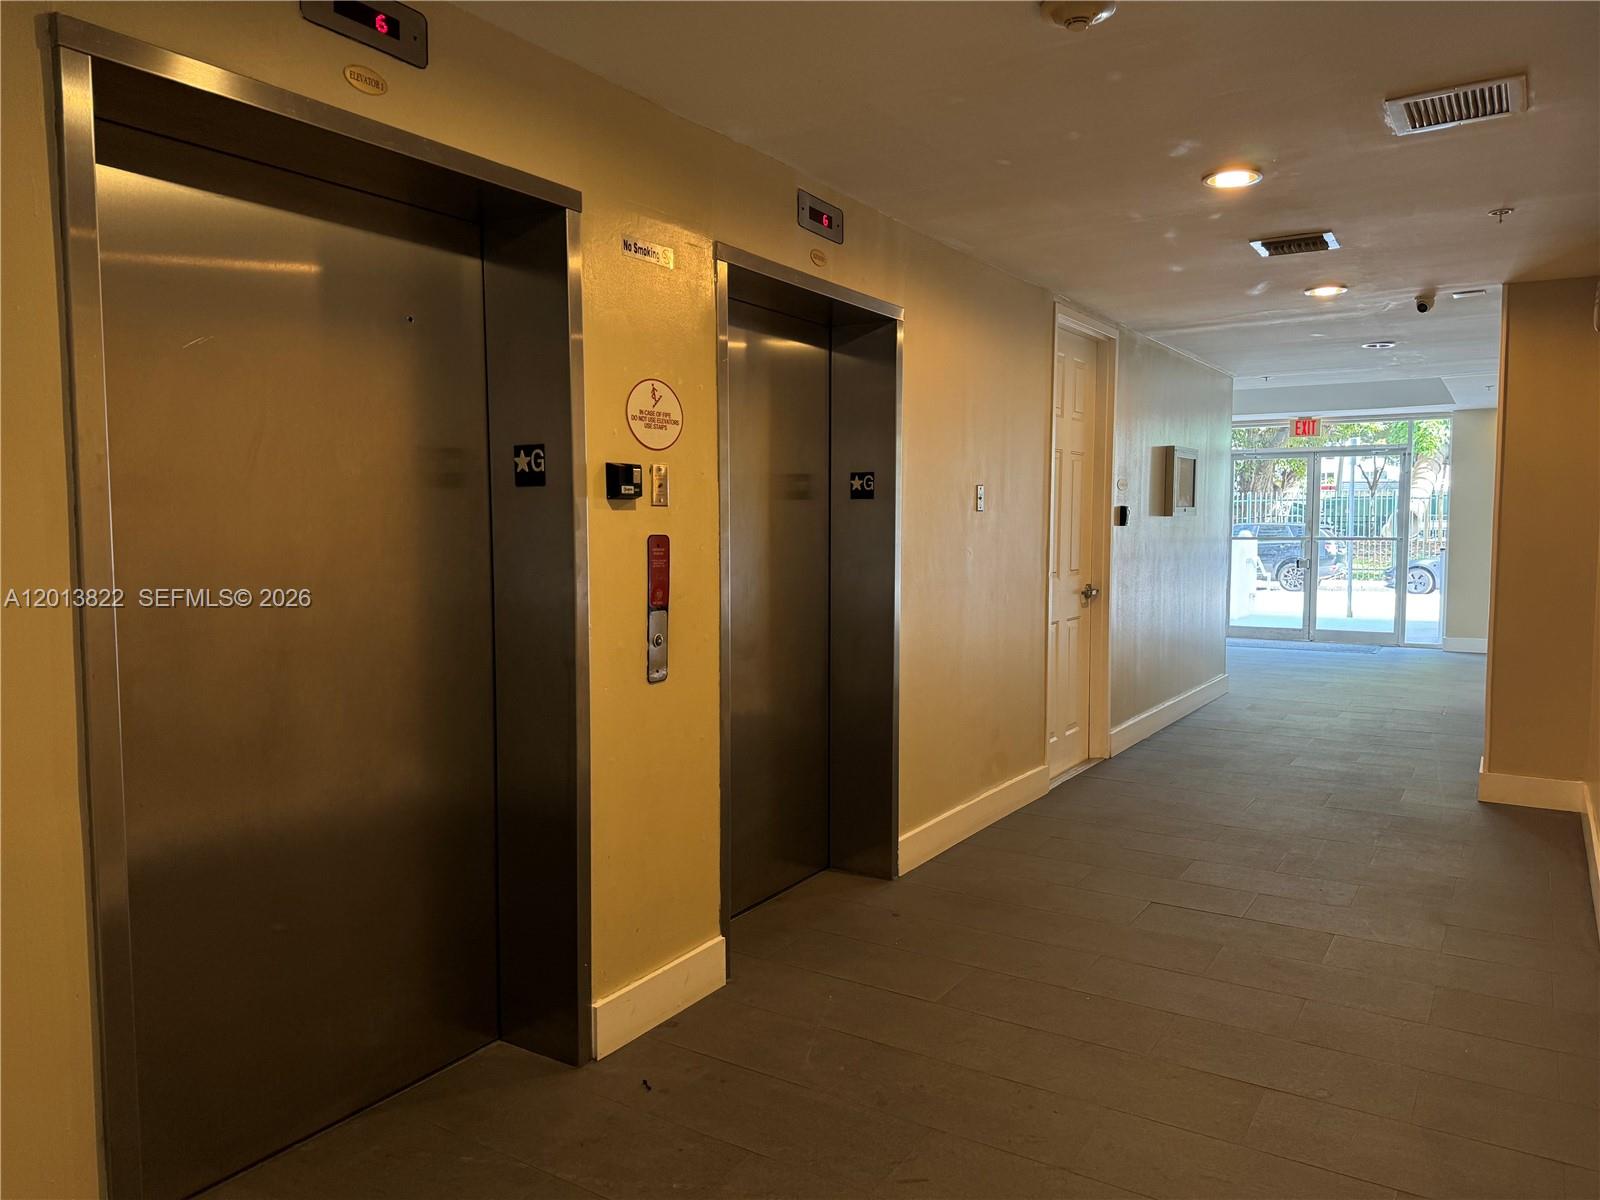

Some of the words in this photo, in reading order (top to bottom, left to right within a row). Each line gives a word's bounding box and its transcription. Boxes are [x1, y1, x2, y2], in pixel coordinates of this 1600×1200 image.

[375, 13, 389, 34] 6
[349, 70, 380, 90] ELEVATOR
[822, 214, 829, 227] 6
[623, 239, 633, 252] No
[633, 242, 660, 263] Smoking
[1295, 420, 1317, 436] EXIT
[531, 449, 545, 472] G
[863, 475, 874, 490] G
